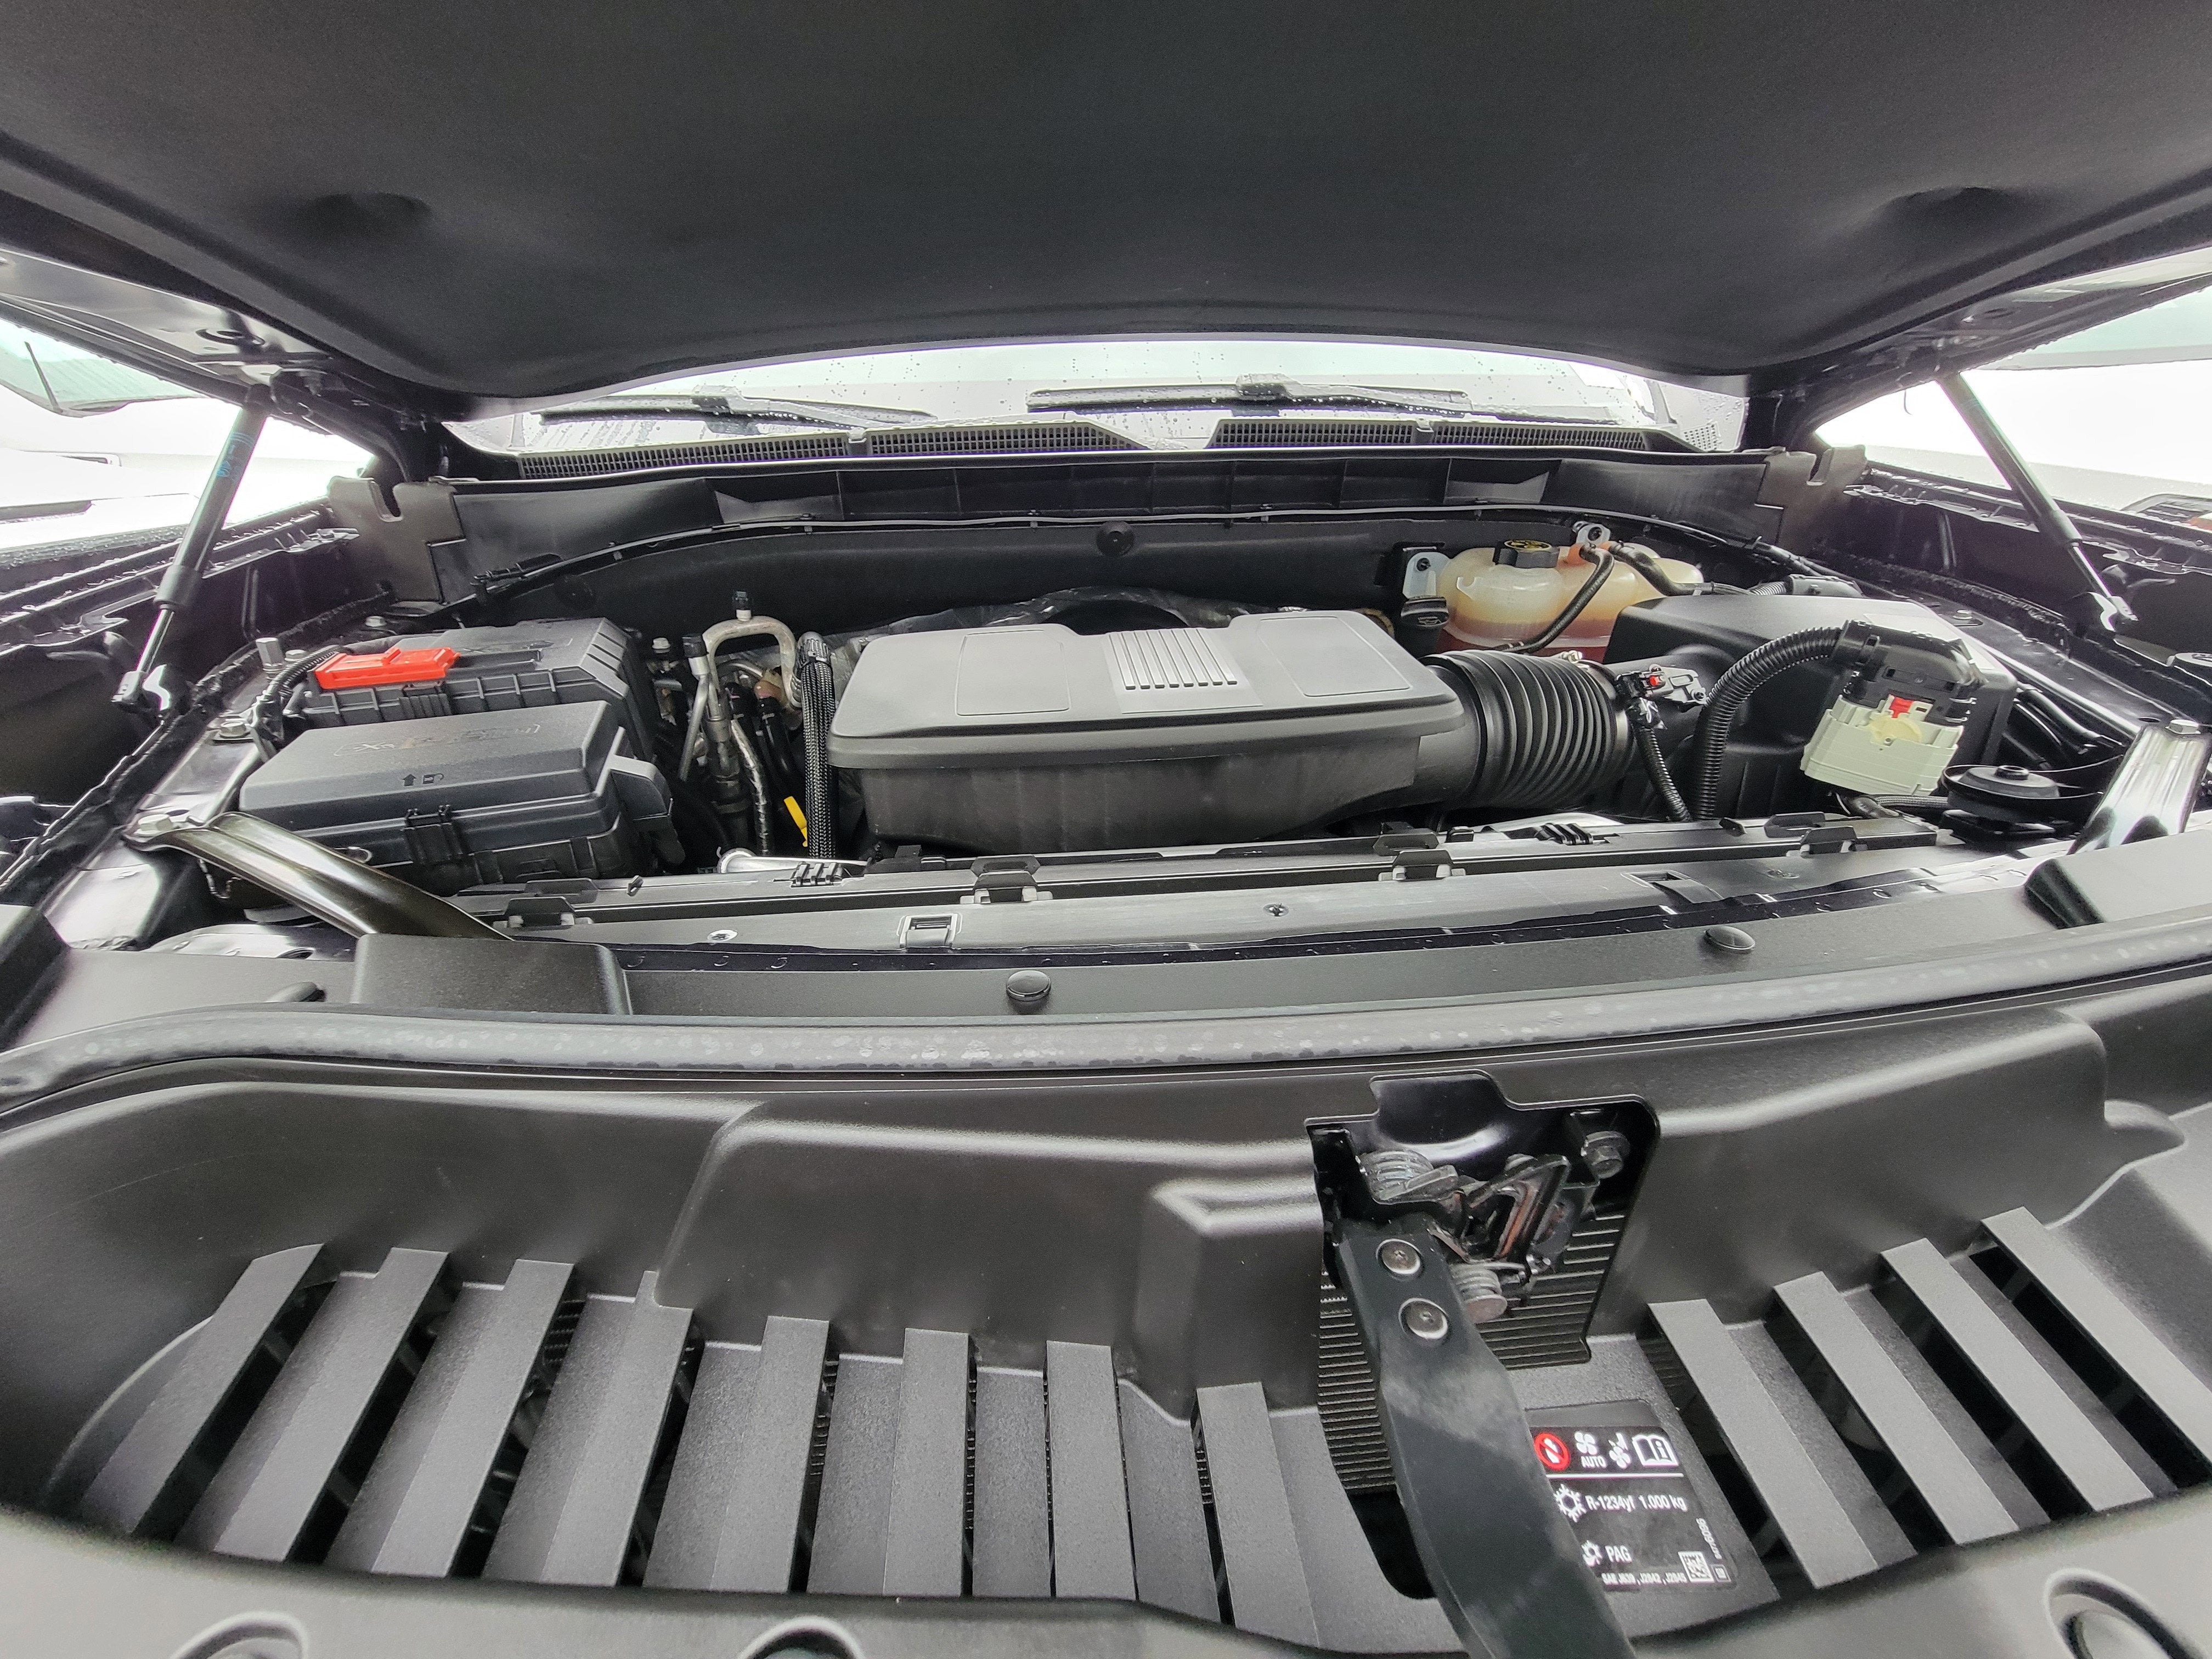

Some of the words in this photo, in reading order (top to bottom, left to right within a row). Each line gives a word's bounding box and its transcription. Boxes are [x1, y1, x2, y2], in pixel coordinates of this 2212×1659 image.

[1581, 1455, 1607, 1469] AUTO
[1585, 1495, 1635, 1513] R-1234yf
[1638, 1494, 1671, 1509] 1.000
[1668, 1494, 1688, 1513] kg
[1605, 1545, 1632, 1562] PAG
